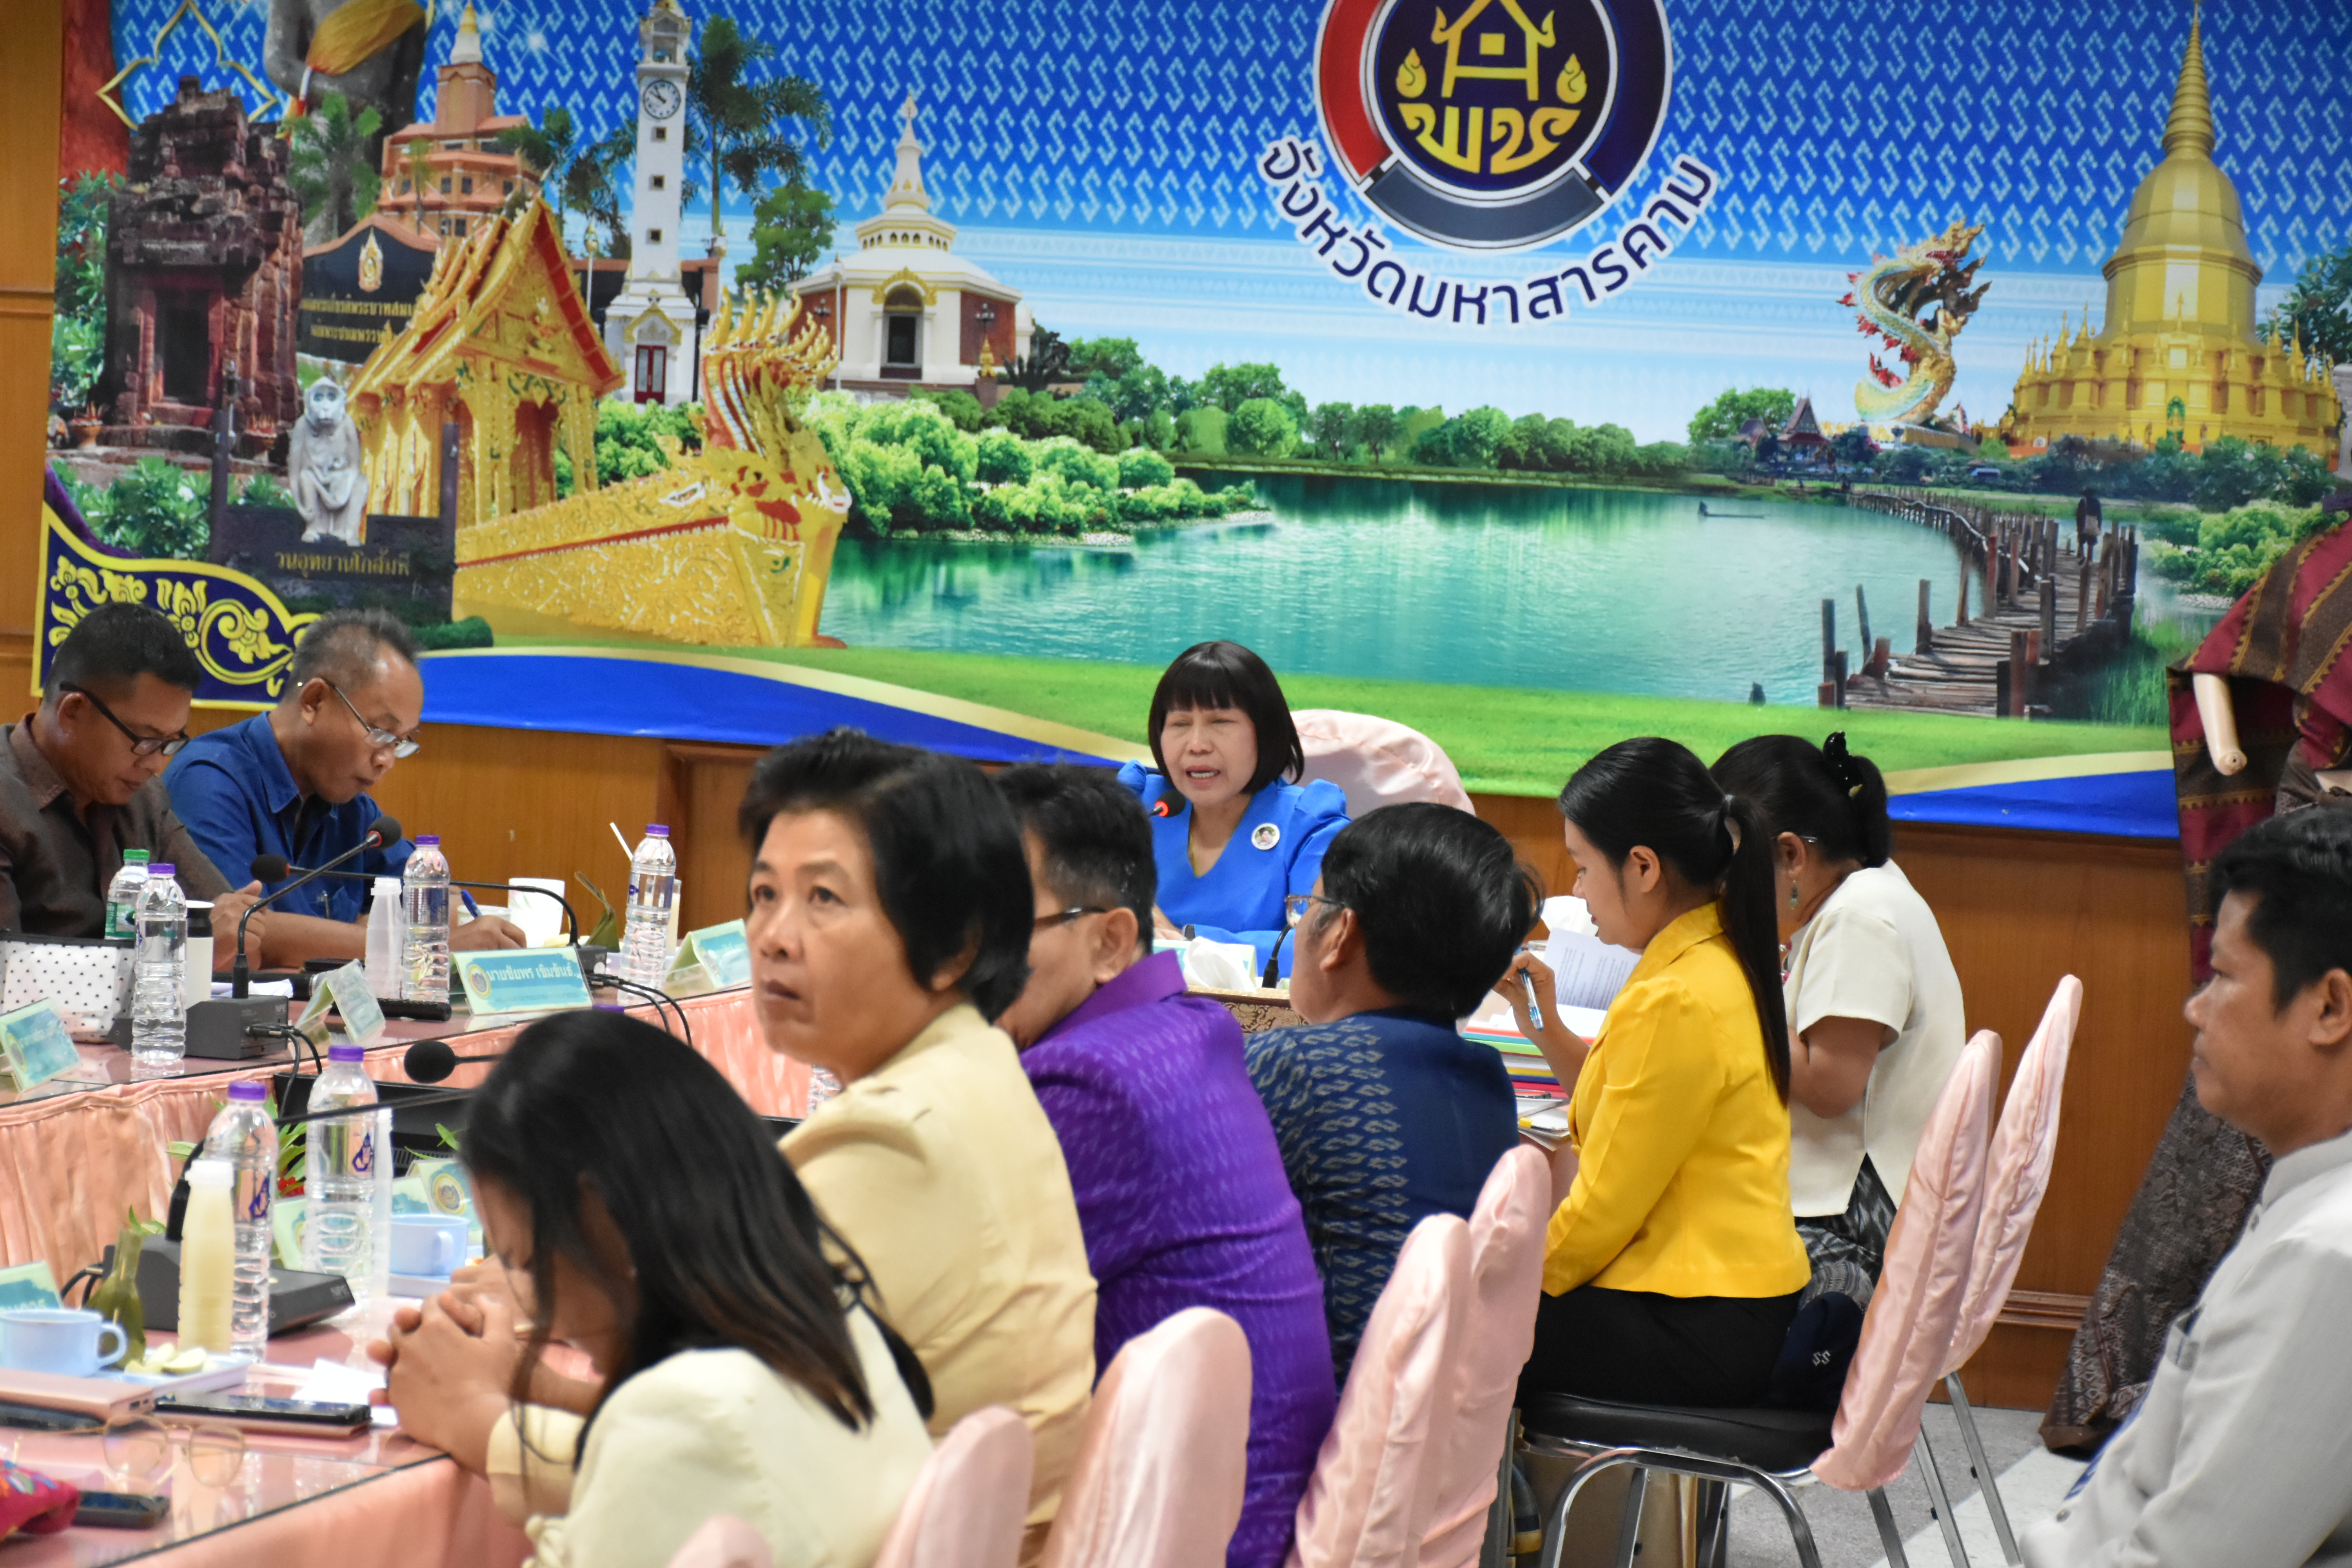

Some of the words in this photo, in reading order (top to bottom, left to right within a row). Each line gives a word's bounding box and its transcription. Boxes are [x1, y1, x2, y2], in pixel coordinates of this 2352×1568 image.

[1263, 142, 1715, 325] จังหวัดมหาสารคาม
